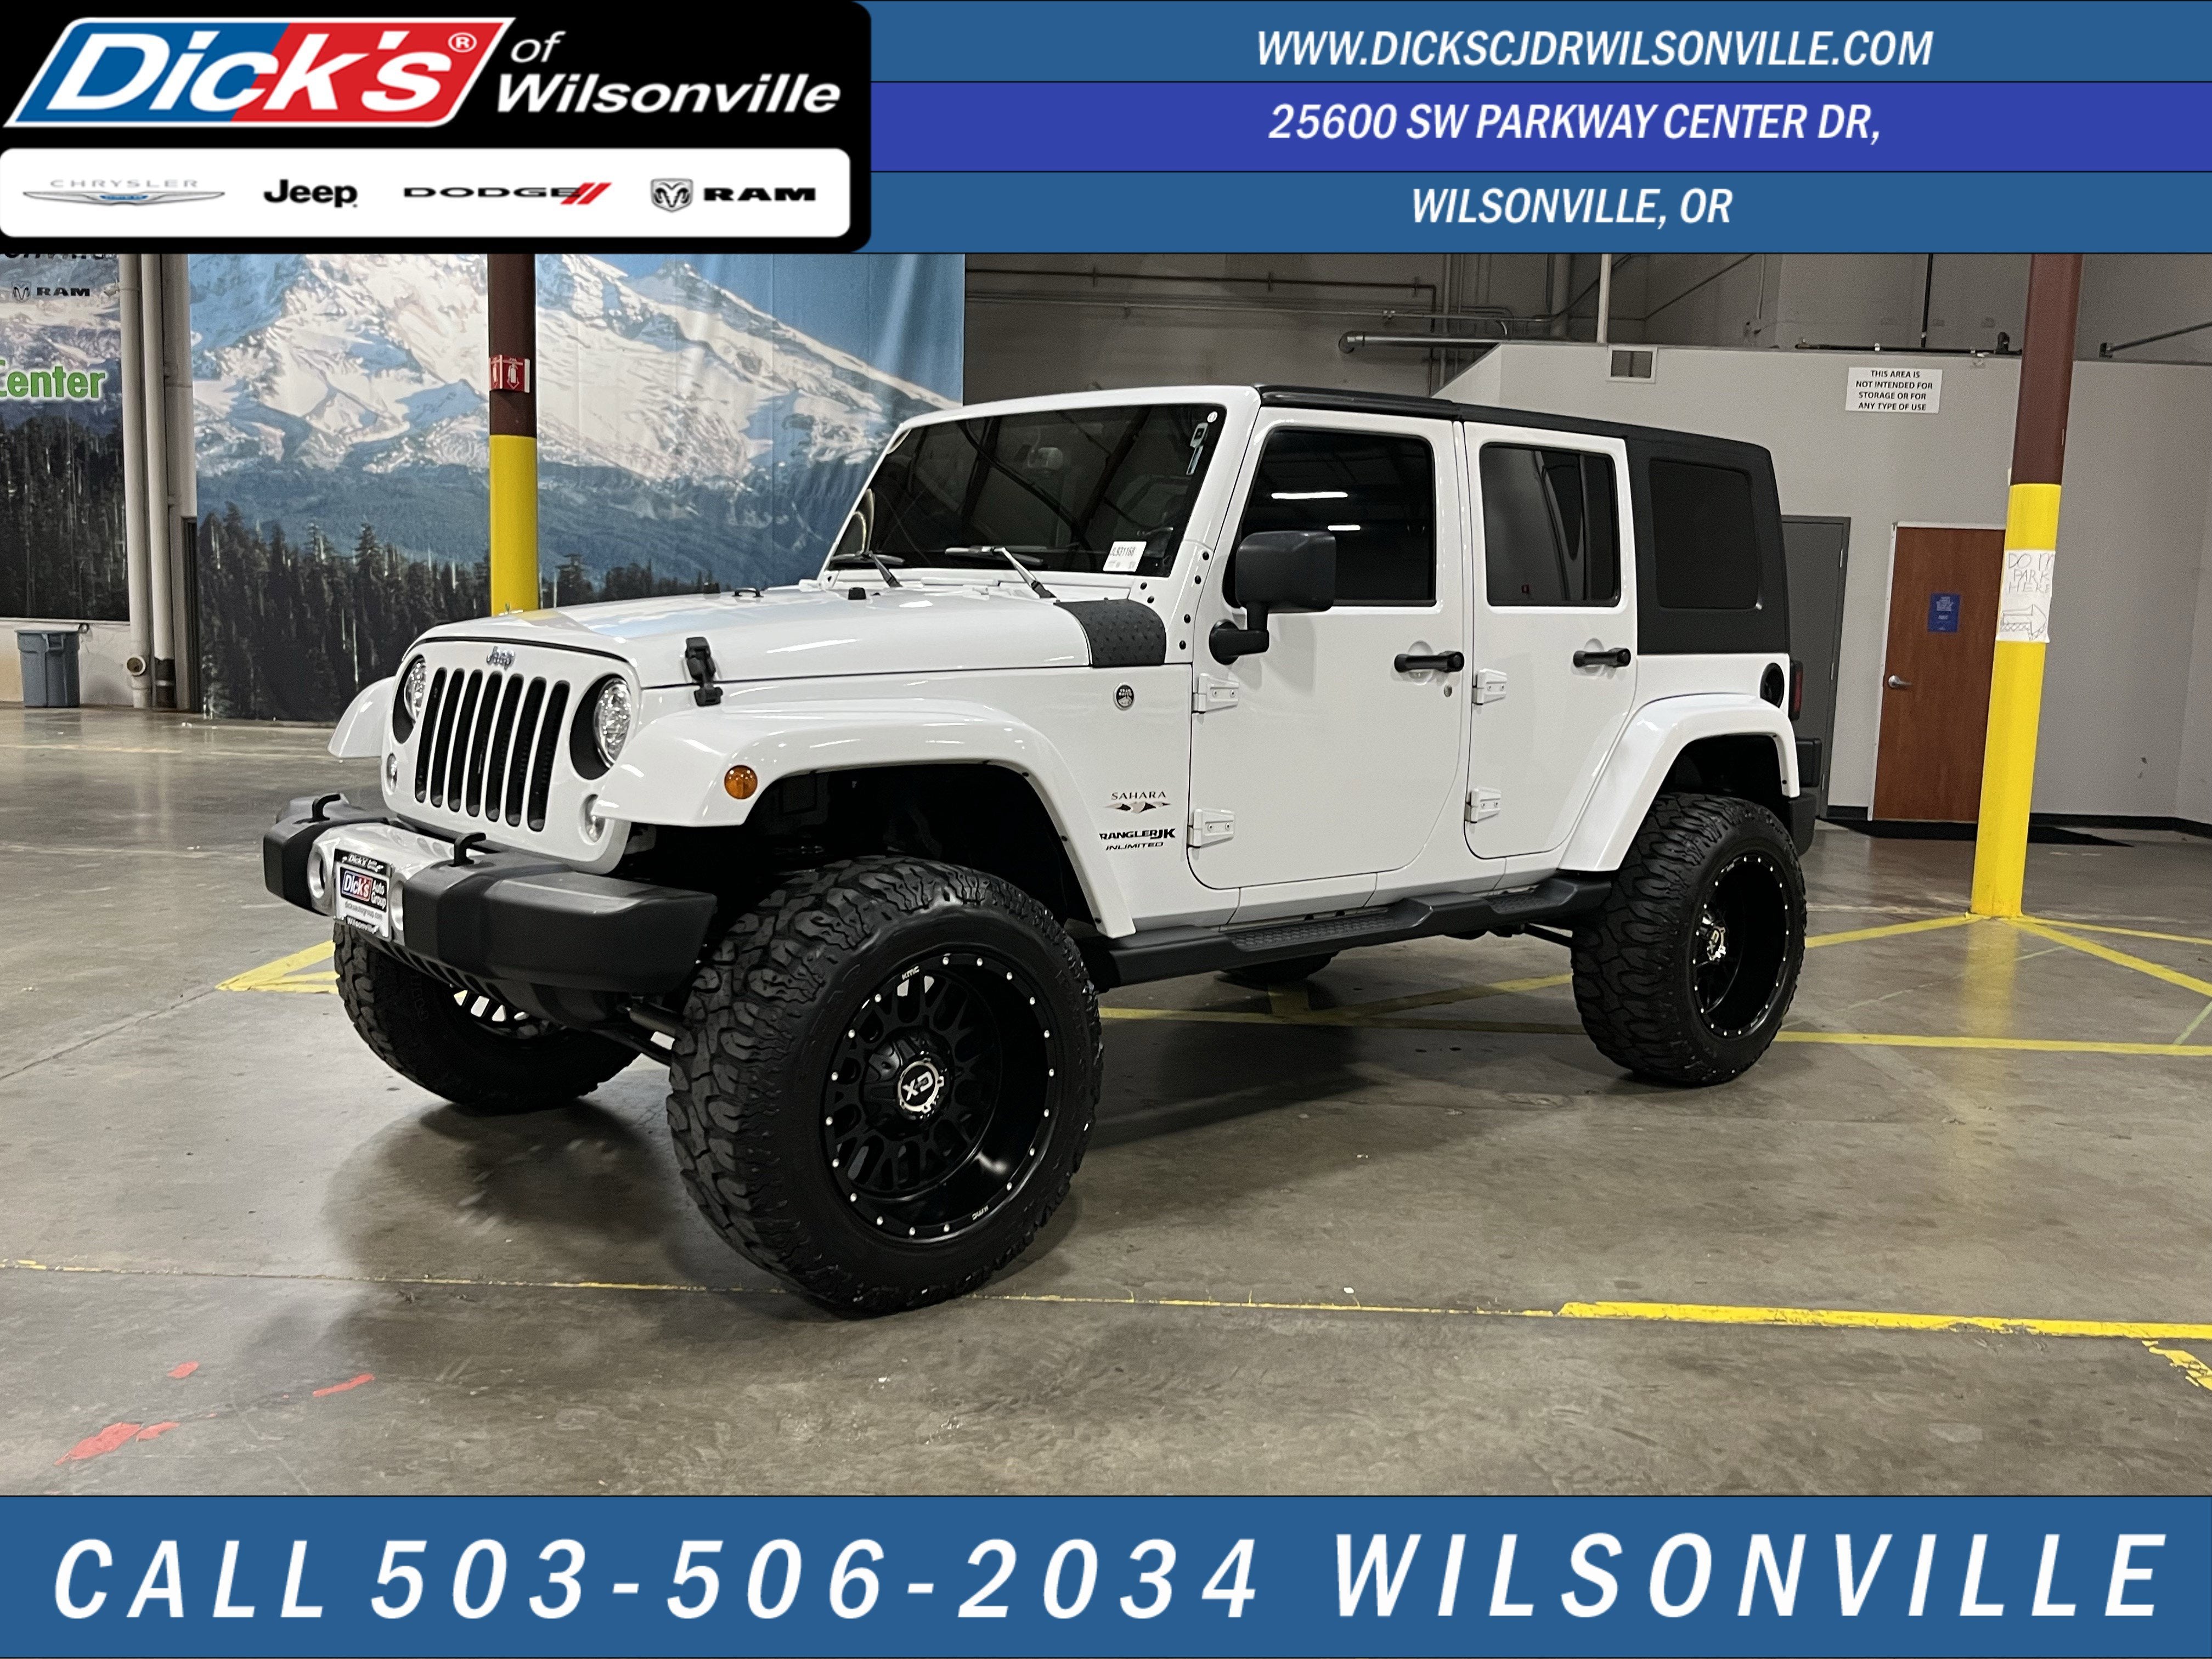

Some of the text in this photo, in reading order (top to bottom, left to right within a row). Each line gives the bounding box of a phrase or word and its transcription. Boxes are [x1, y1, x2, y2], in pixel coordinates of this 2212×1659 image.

[37, 287, 90, 297] RAM
[0, 360, 105, 398] enter
[1871, 370, 1921, 379] THIS AREA IS
[1874, 381, 1915, 389] INTENDED
[1916, 382, 1933, 390] FOR
[1858, 391, 1895, 399] STORAGE
[1910, 392, 1927, 400] FOR
[1858, 402, 1875, 410] ANY
[2008, 552, 2032, 569] DO
[2013, 568, 2050, 584] PARK
[2008, 581, 2051, 594] HERE
[1111, 791, 1166, 800] SAHARA
[343, 873, 370, 898] Dick's
[371, 891, 386, 910] Group
[902, 1071, 933, 1102] XD
